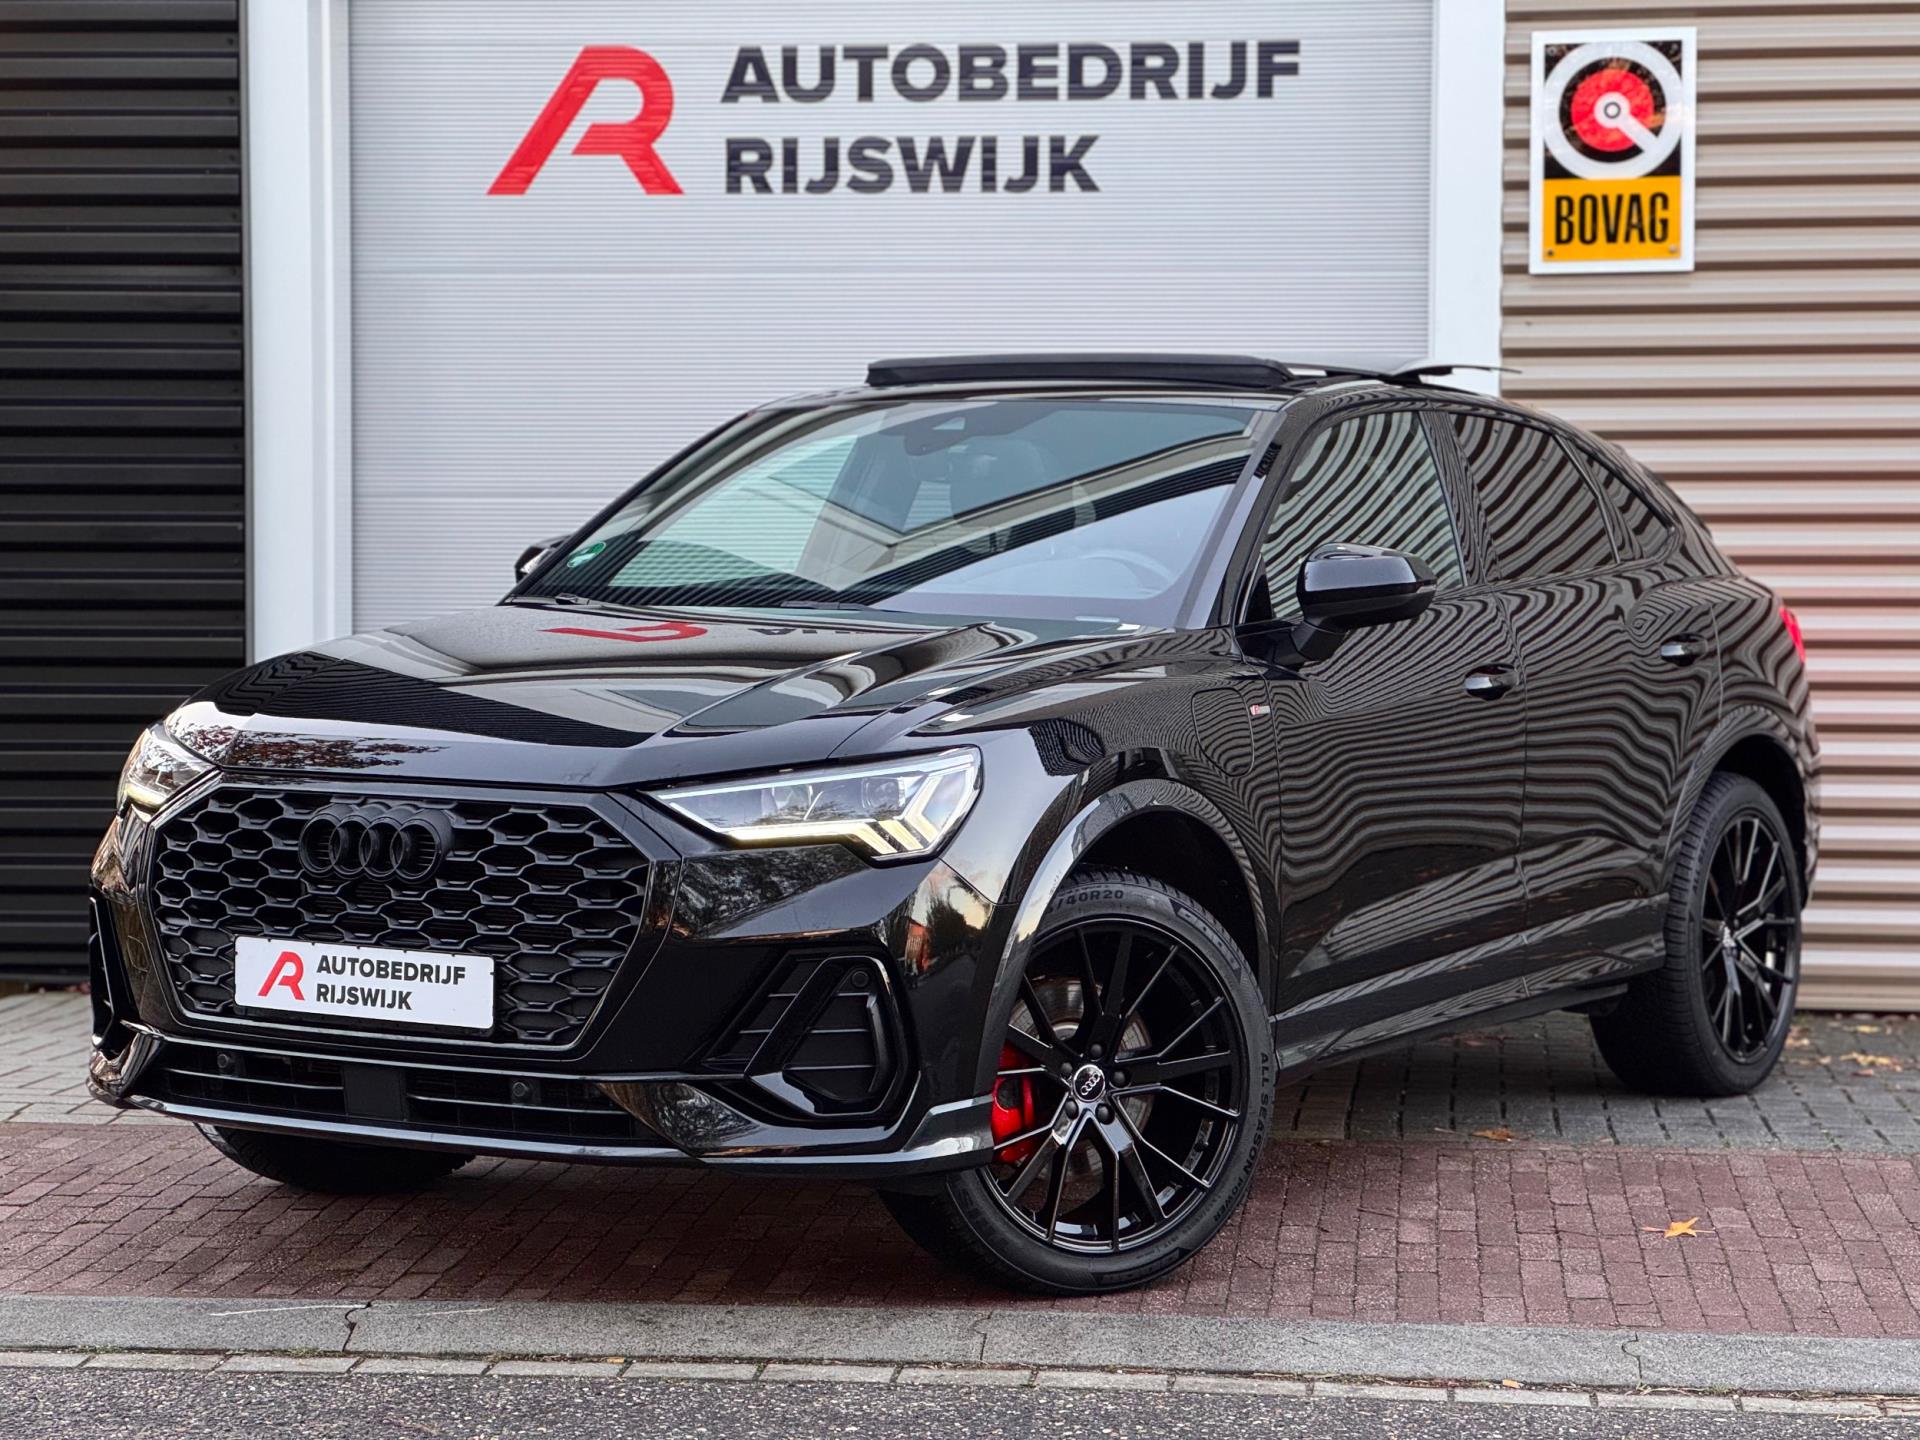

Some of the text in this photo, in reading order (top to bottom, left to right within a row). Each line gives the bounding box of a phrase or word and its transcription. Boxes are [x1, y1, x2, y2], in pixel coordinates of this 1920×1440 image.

[721, 41, 1300, 103] AUTOBEDRIJF
[725, 135, 1100, 194] RIJSWIJK
[1555, 192, 1669, 245] BOVAG
[316, 954, 466, 985] AUTOBEDRIJF
[316, 983, 412, 1010] RIJSWIJK
[1260, 1052, 1270, 1087] ALL
[1242, 1093, 1269, 1174] SEASON
